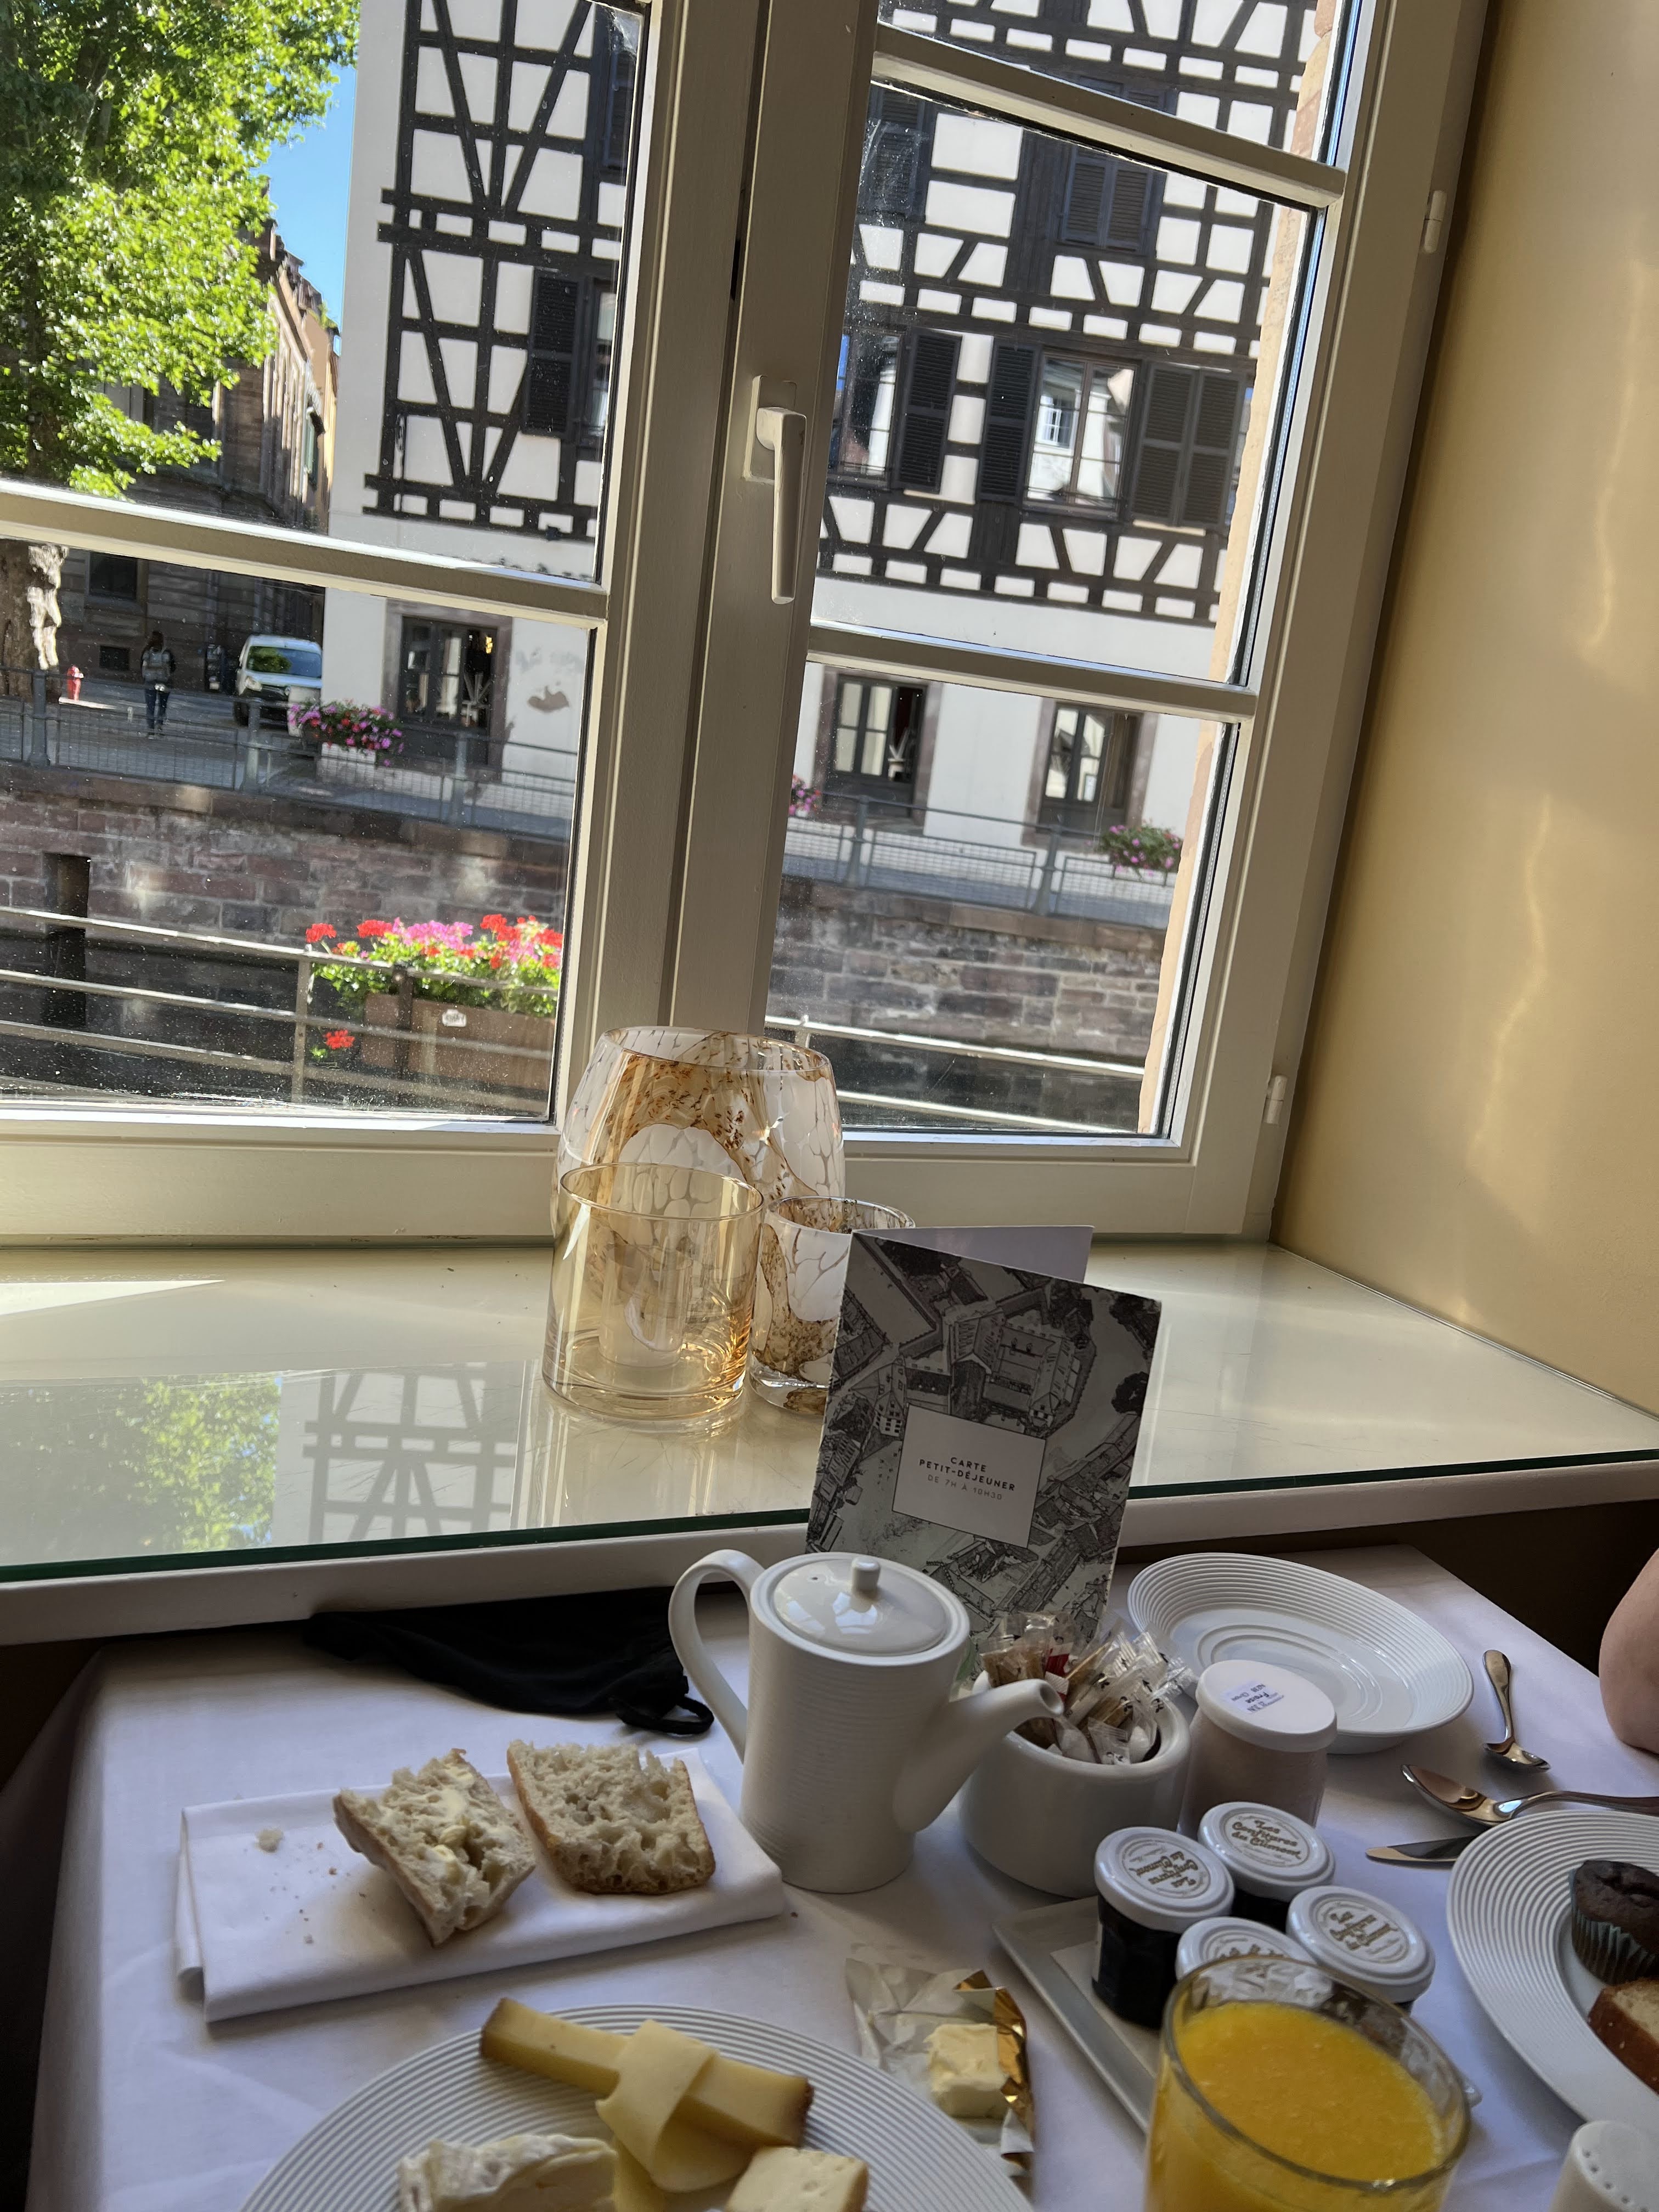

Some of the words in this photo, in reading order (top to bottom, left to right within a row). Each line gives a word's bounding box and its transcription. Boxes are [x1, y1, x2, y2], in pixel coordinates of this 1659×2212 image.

[919, 1459, 1015, 1491] PETIT-DÉJEUNER
[950, 1457, 987, 1472] CARTE
[927, 1474, 939, 1483] DE
[945, 1479, 957, 1488] 7H
[961, 1482, 967, 1491] À
[973, 1487, 1003, 1500] 10H30
